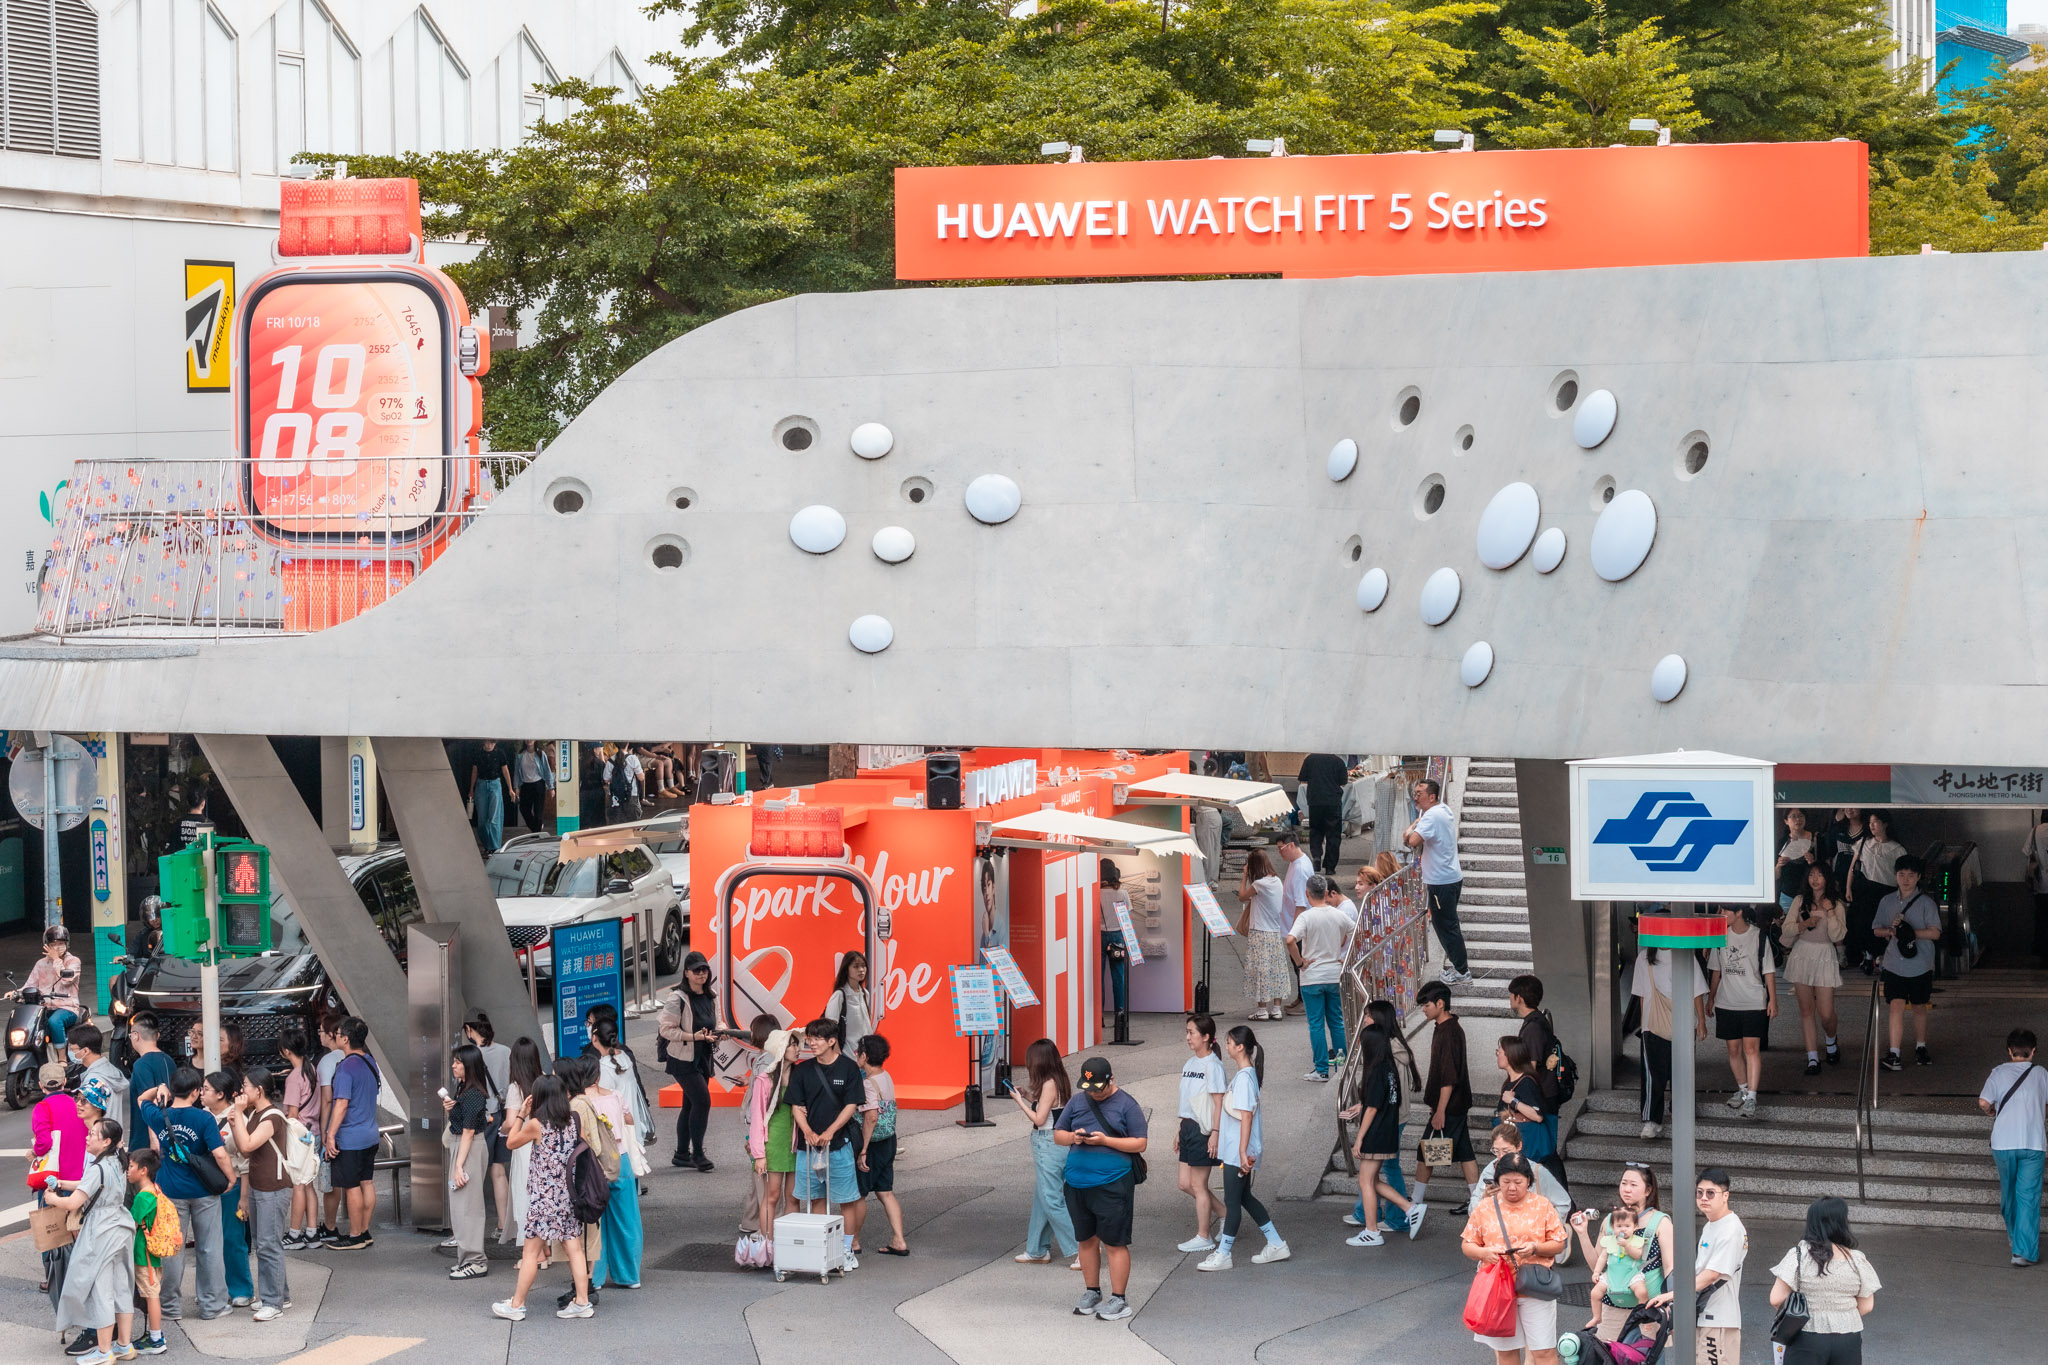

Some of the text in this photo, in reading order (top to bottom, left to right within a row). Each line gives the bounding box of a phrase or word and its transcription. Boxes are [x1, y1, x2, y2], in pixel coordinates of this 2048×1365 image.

[937, 190, 1548, 239] HUAWEI WATCH FIT 5 Series
[266, 316, 320, 329] FRI 10/18
[353, 317, 376, 327] 2752
[401, 305, 422, 336] 7645
[212, 295, 231, 363] matsukiyo
[368, 344, 391, 354] 2552
[271, 343, 367, 410] 10
[378, 375, 400, 385] 2352
[379, 397, 404, 409] 97%
[380, 412, 402, 421] SpO2
[258, 412, 365, 477] 08
[378, 435, 400, 444] 1952
[332, 494, 356, 506] 80%
[970, 759, 1037, 808] HUAWEI
[1933, 769, 2043, 793] 中山地下街
[1061, 790, 1080, 808] HUAWEI
[1548, 854, 1560, 862] 16
[709, 850, 955, 951] Spark Your
[570, 928, 604, 943] HUAWEI
[561, 944, 583, 956] WATCH
[583, 943, 591, 952] FIT
[597, 941, 614, 950] Series
[1044, 851, 1098, 1059] FIT
